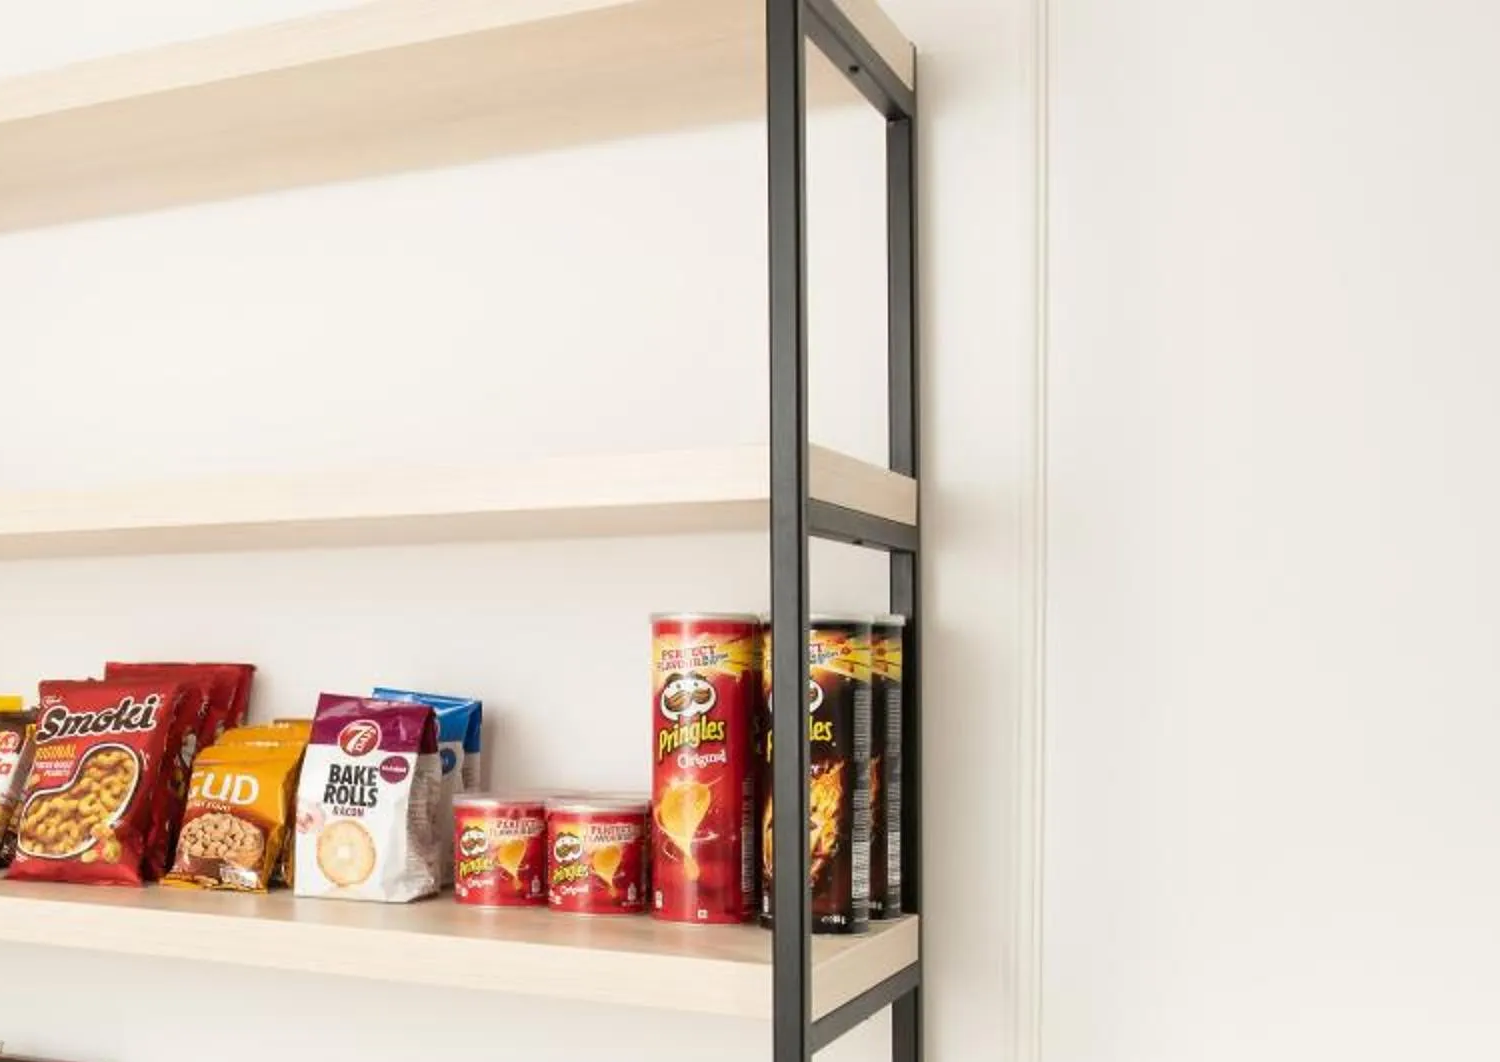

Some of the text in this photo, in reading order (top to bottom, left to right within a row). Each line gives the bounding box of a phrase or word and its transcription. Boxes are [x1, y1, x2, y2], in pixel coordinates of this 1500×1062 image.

[36, 694, 160, 744] Smoki
[658, 715, 726, 762] Pringles
[677, 748, 728, 769] Original
[329, 764, 379, 787] BAKE
[322, 784, 379, 808] ROLLS
[332, 805, 365, 818] BACON
